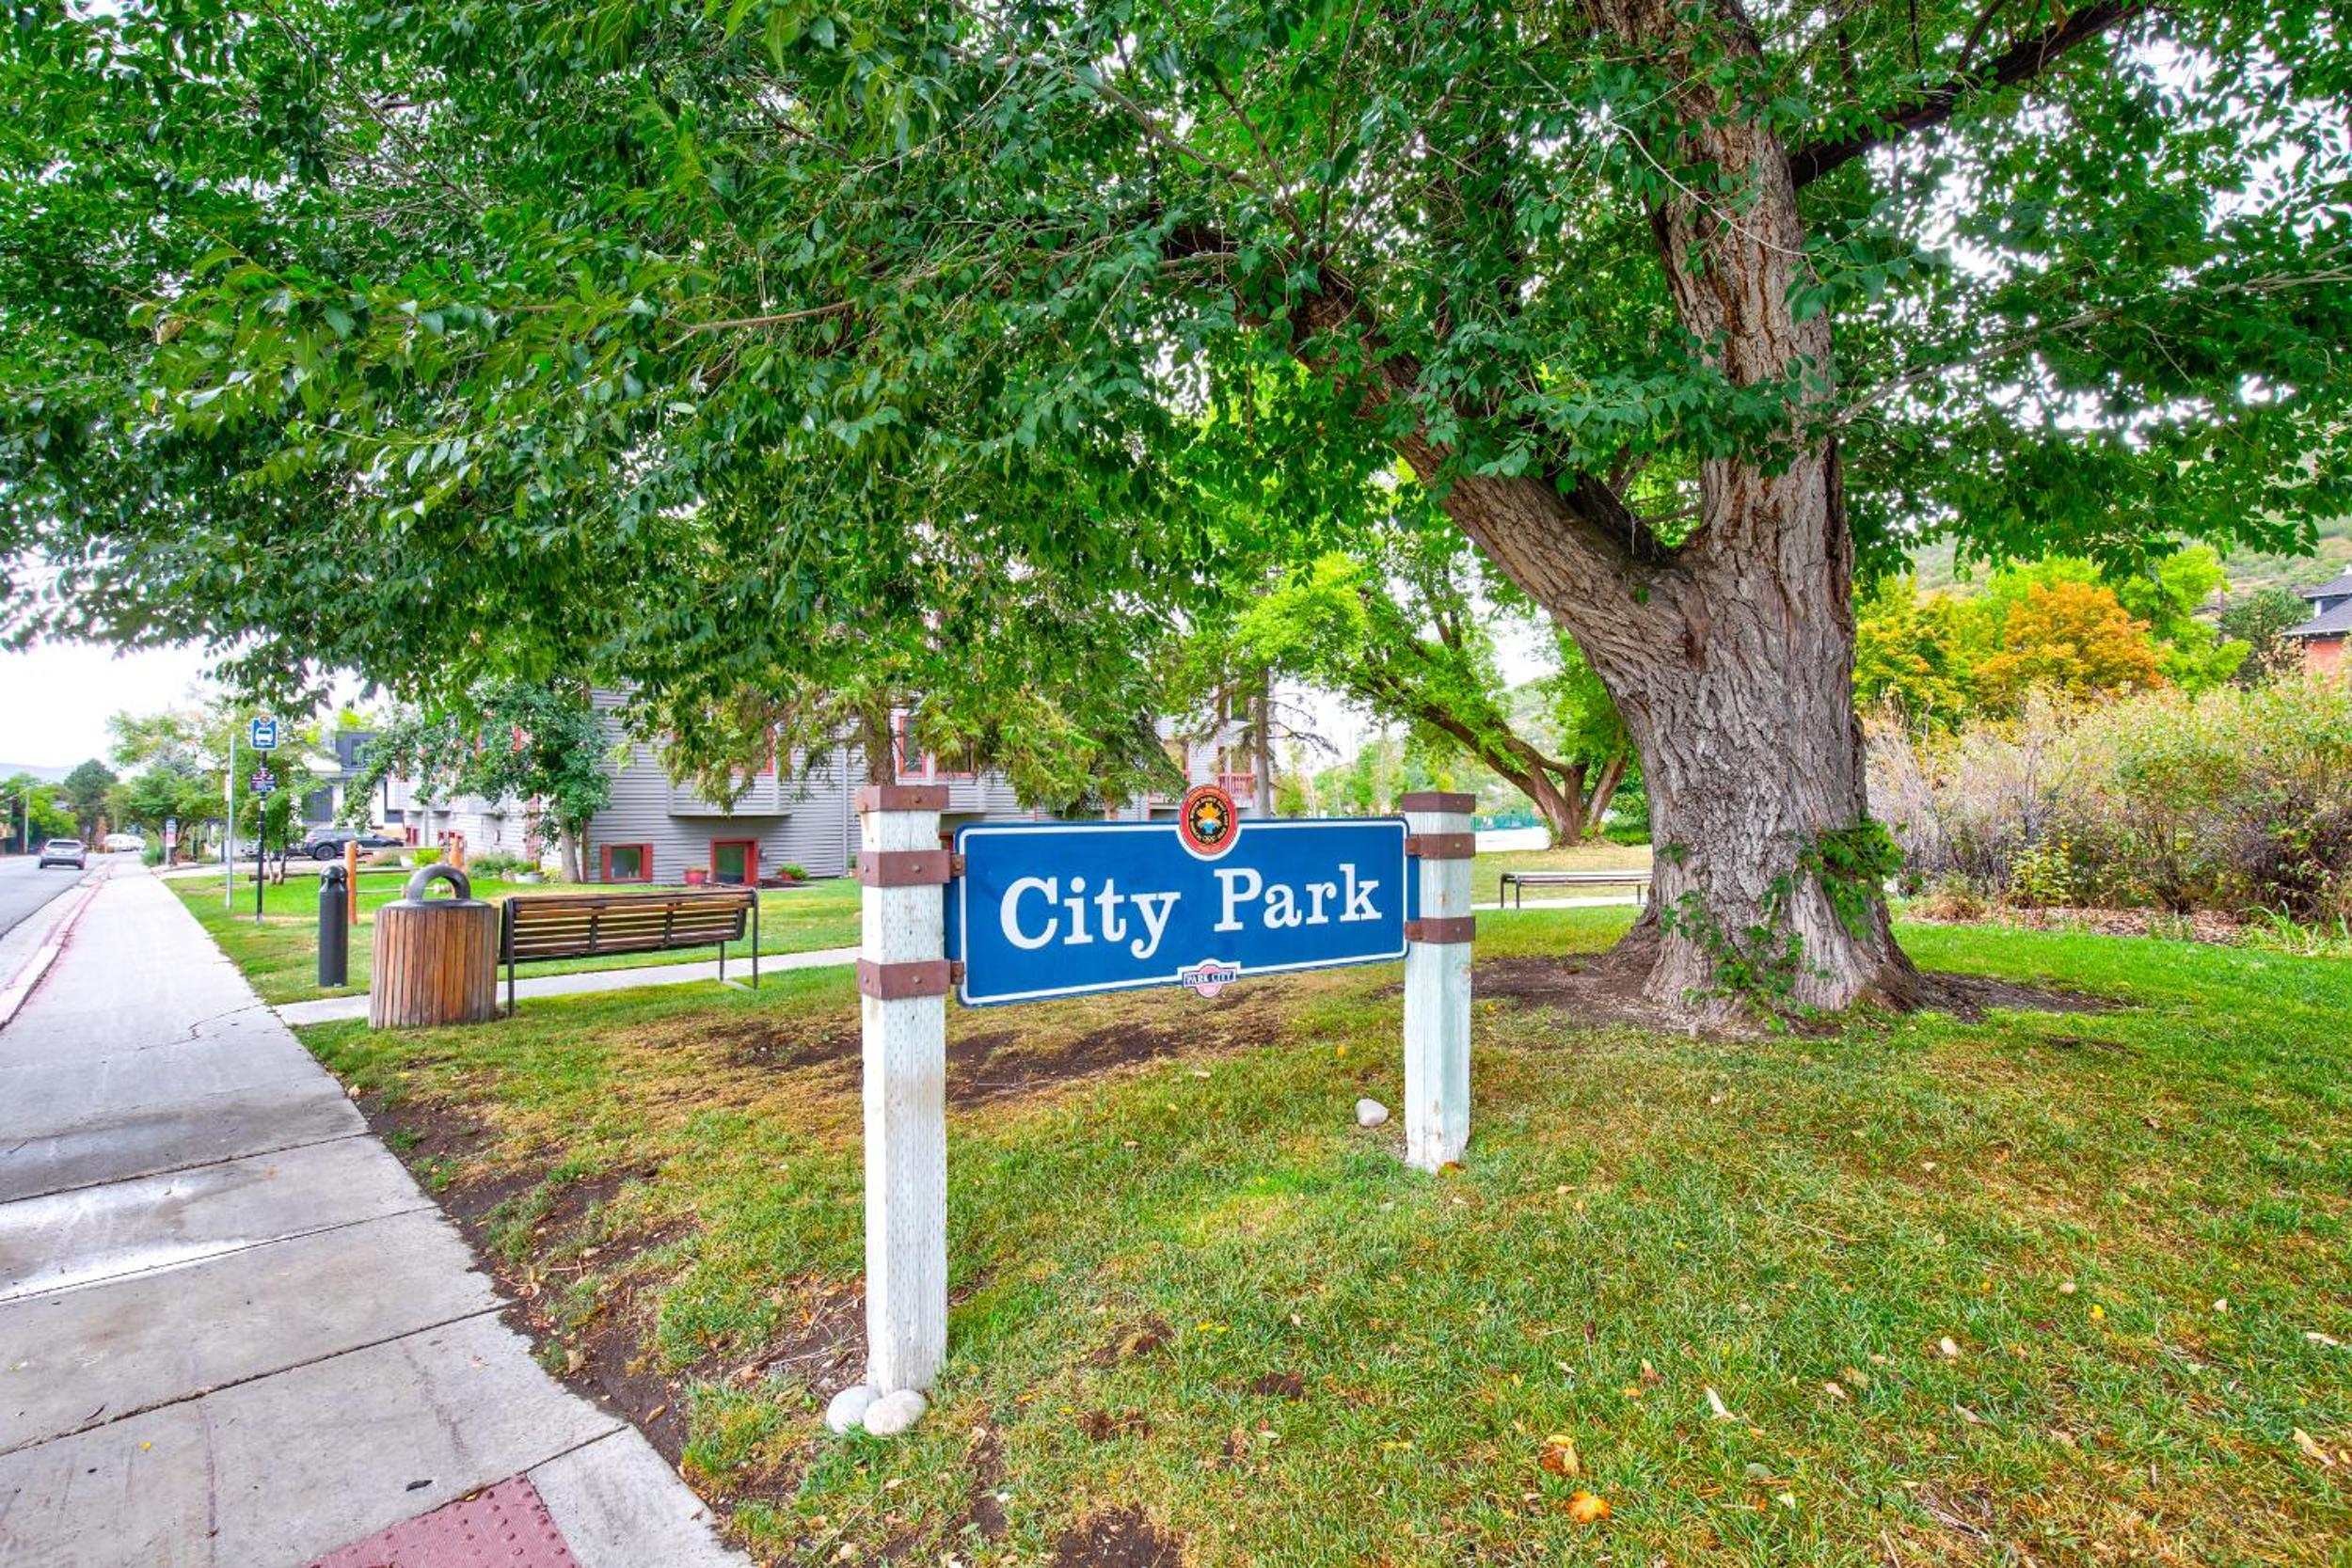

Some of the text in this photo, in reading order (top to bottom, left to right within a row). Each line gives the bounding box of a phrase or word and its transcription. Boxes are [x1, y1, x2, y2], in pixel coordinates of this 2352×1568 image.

[999, 863, 1382, 959] City Park
[1185, 970, 1233, 985] PARK CITY
